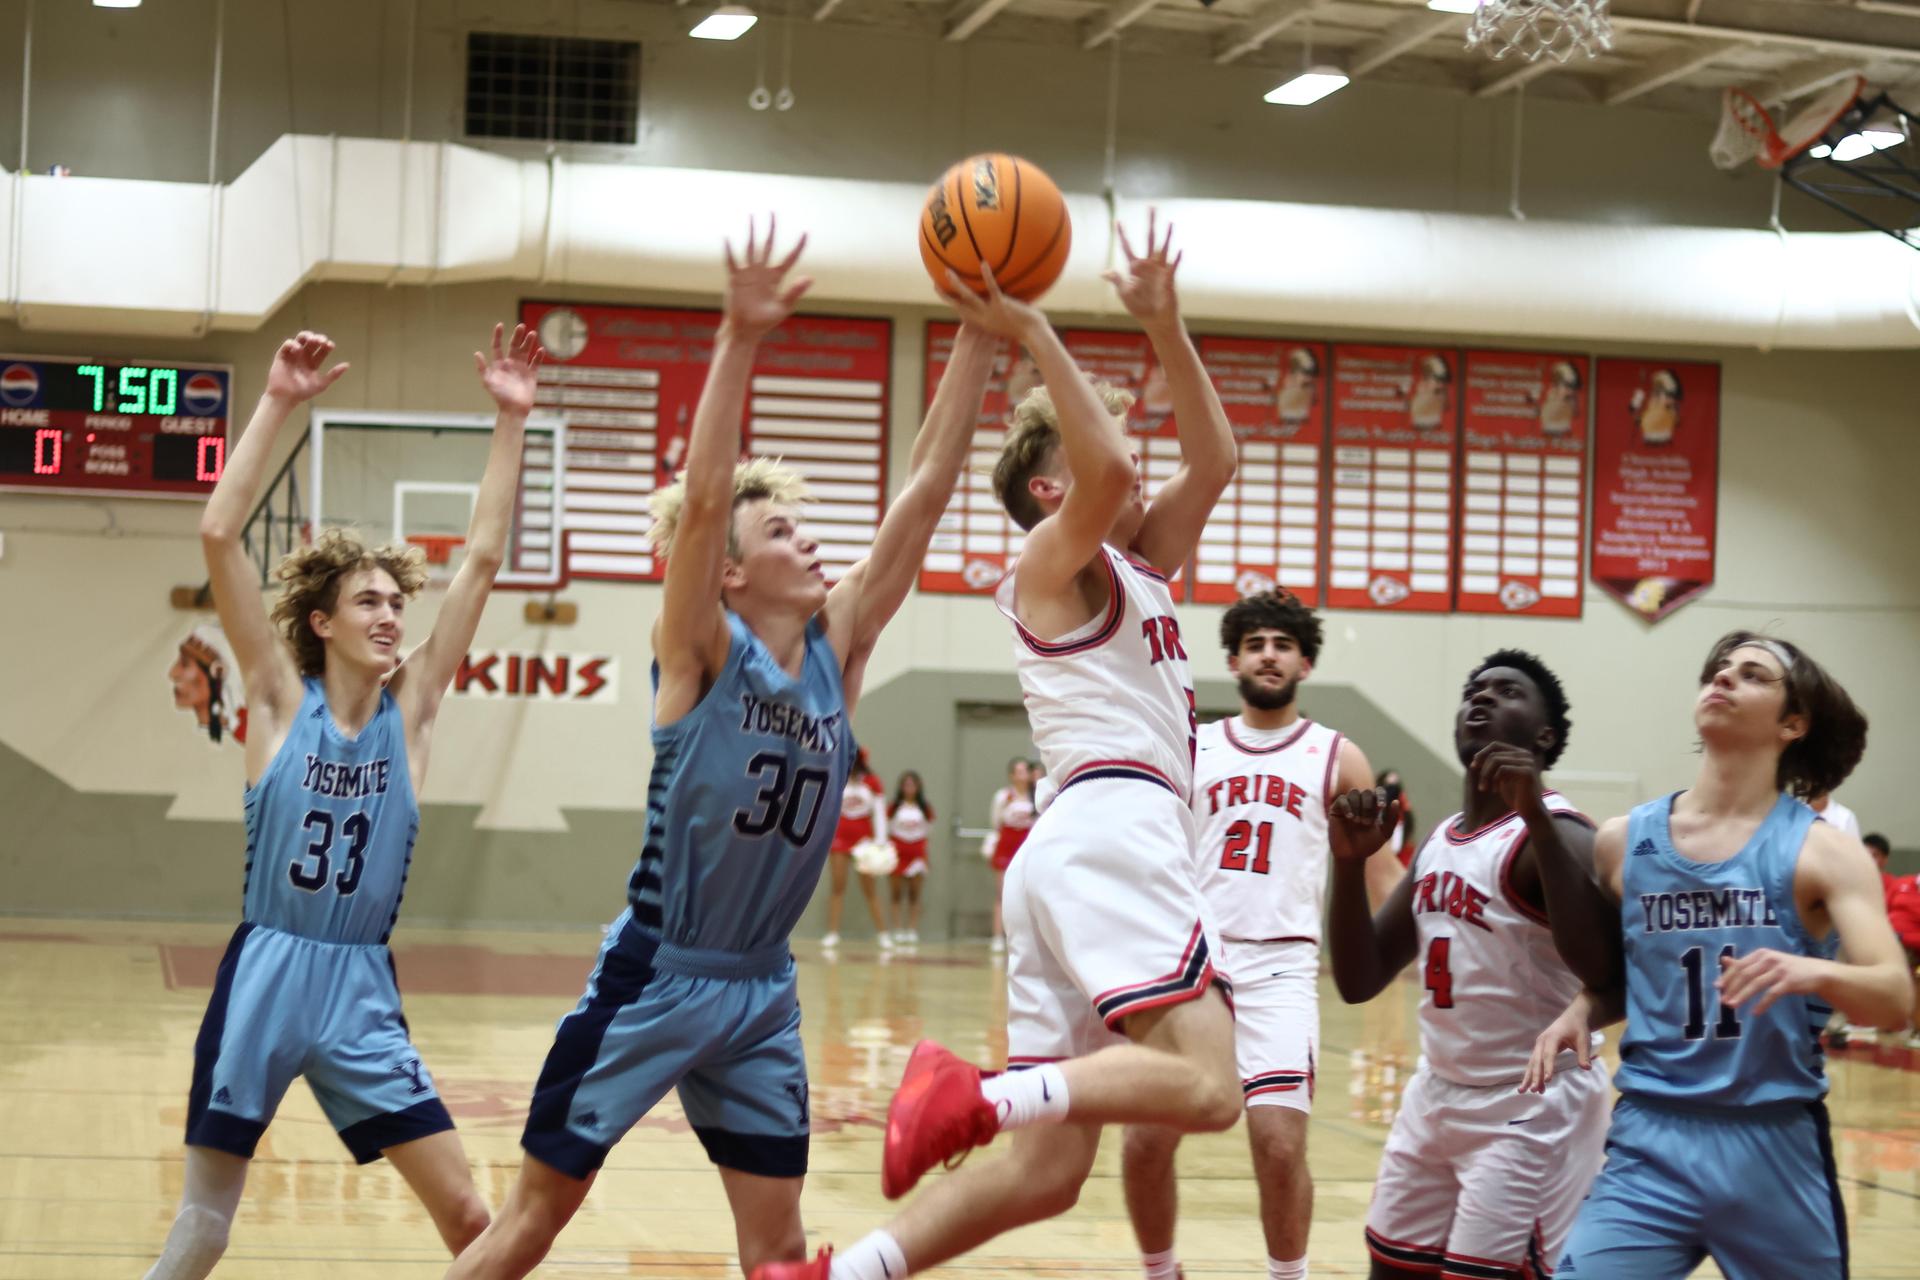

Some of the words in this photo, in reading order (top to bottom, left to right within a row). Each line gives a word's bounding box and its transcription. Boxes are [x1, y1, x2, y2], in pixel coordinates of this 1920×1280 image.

[1, 409, 49, 427] HOME
[160, 416, 217, 434] GUEST
[33, 428, 62, 475] 0
[195, 436, 225, 482] 0
[731, 750, 831, 848] 30
[1207, 774, 1308, 821] TRIBE
[287, 809, 372, 897] 33
[1219, 819, 1275, 876] 21
[1425, 936, 1454, 1010] 4
[1680, 944, 1743, 1041] 11
[391, 1057, 430, 1097] Y
